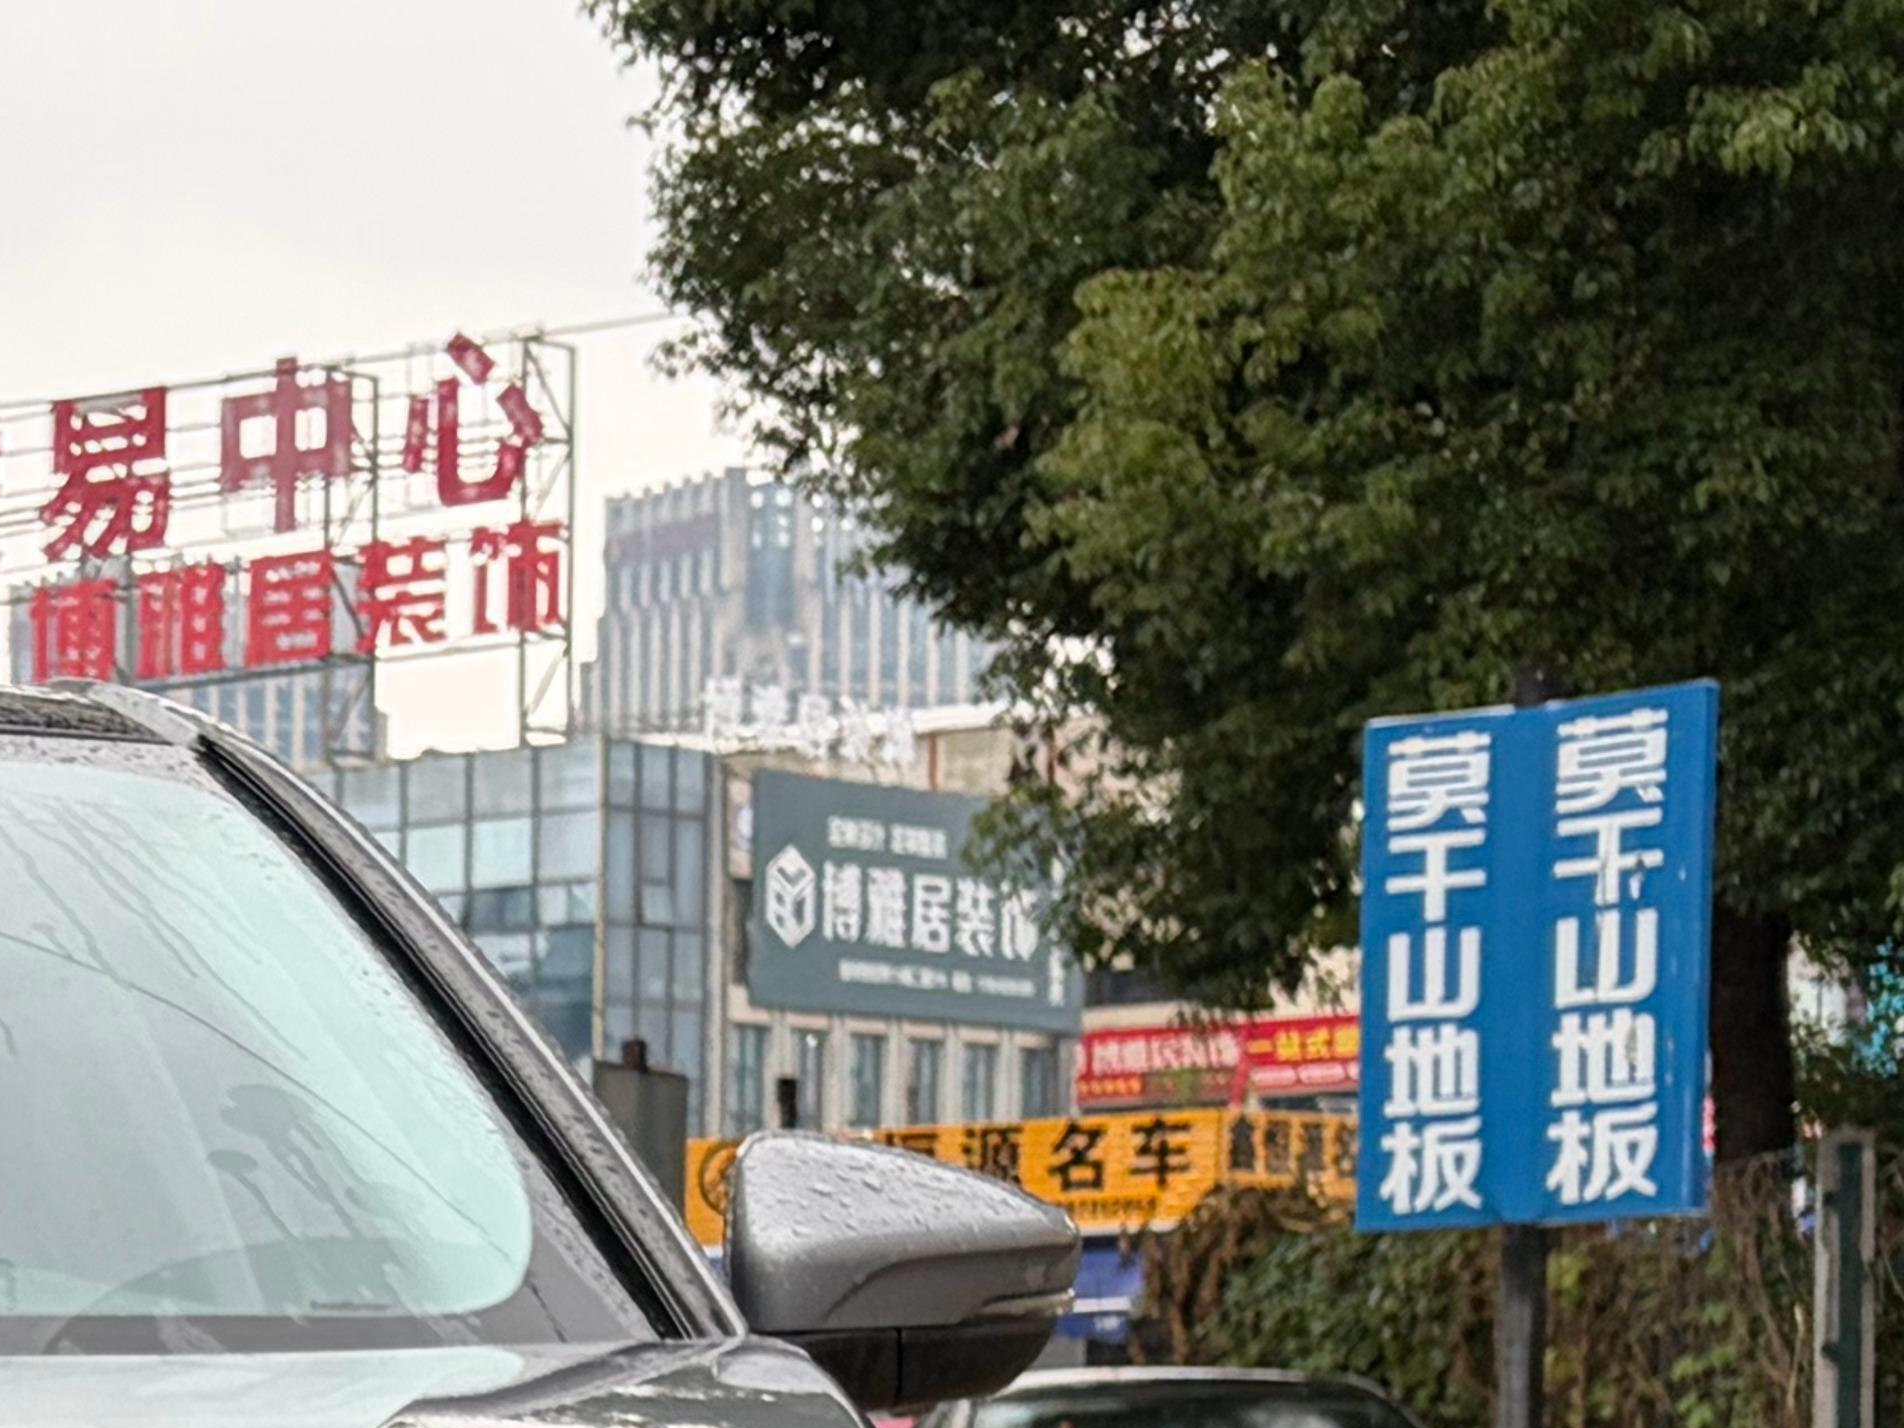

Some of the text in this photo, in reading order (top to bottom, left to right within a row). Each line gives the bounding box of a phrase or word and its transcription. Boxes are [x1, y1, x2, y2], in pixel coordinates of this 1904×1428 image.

[1379, 731, 1491, 1216] 莫干山地板
[1546, 707, 1668, 1205] 莫干山地板
